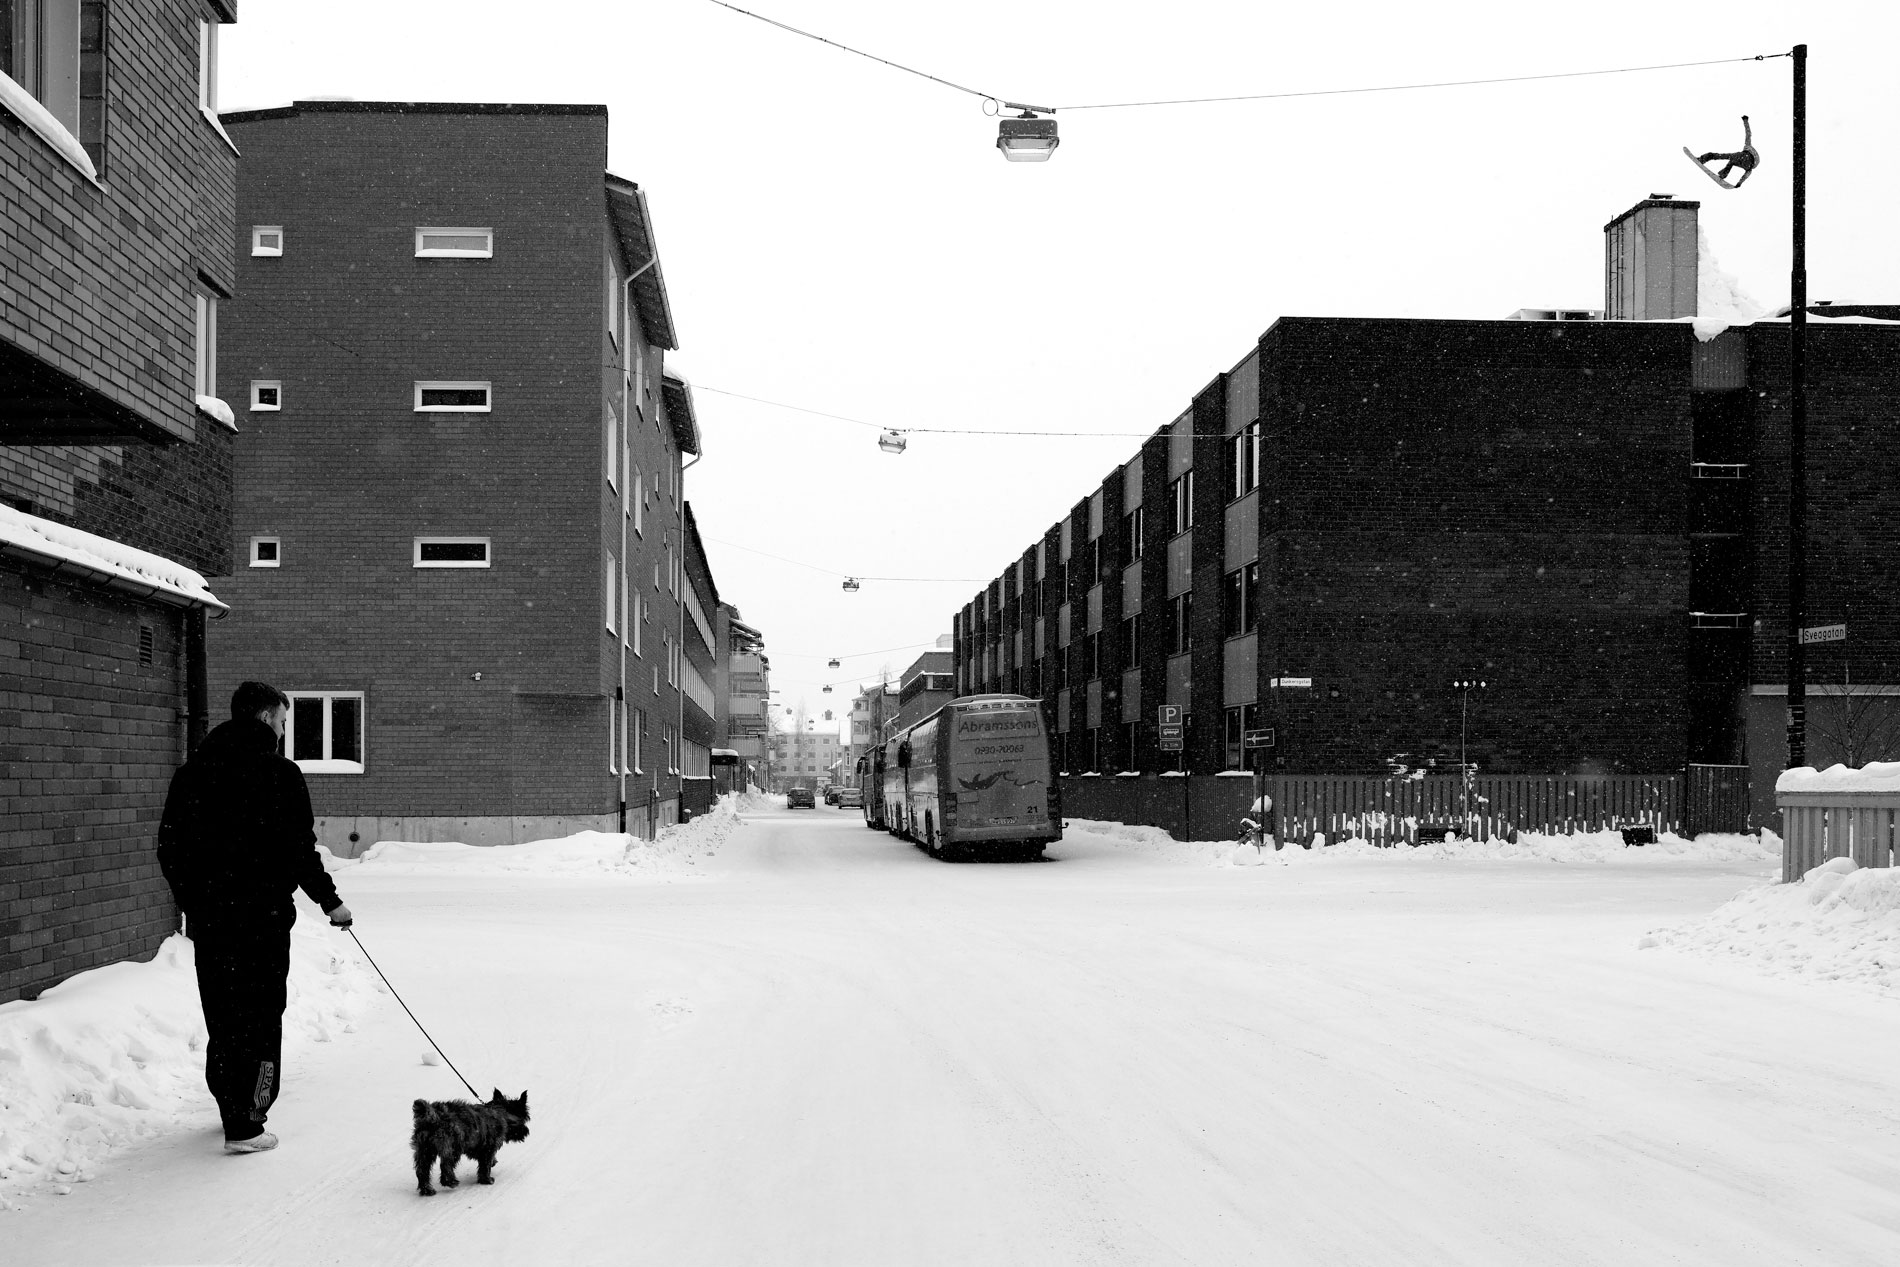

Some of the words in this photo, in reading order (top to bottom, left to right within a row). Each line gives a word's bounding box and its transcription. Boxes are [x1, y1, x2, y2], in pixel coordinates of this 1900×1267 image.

[1804, 627, 1845, 641] Sveagatan
[1165, 707, 1177, 722] P
[960, 720, 1037, 733] Abramssons
